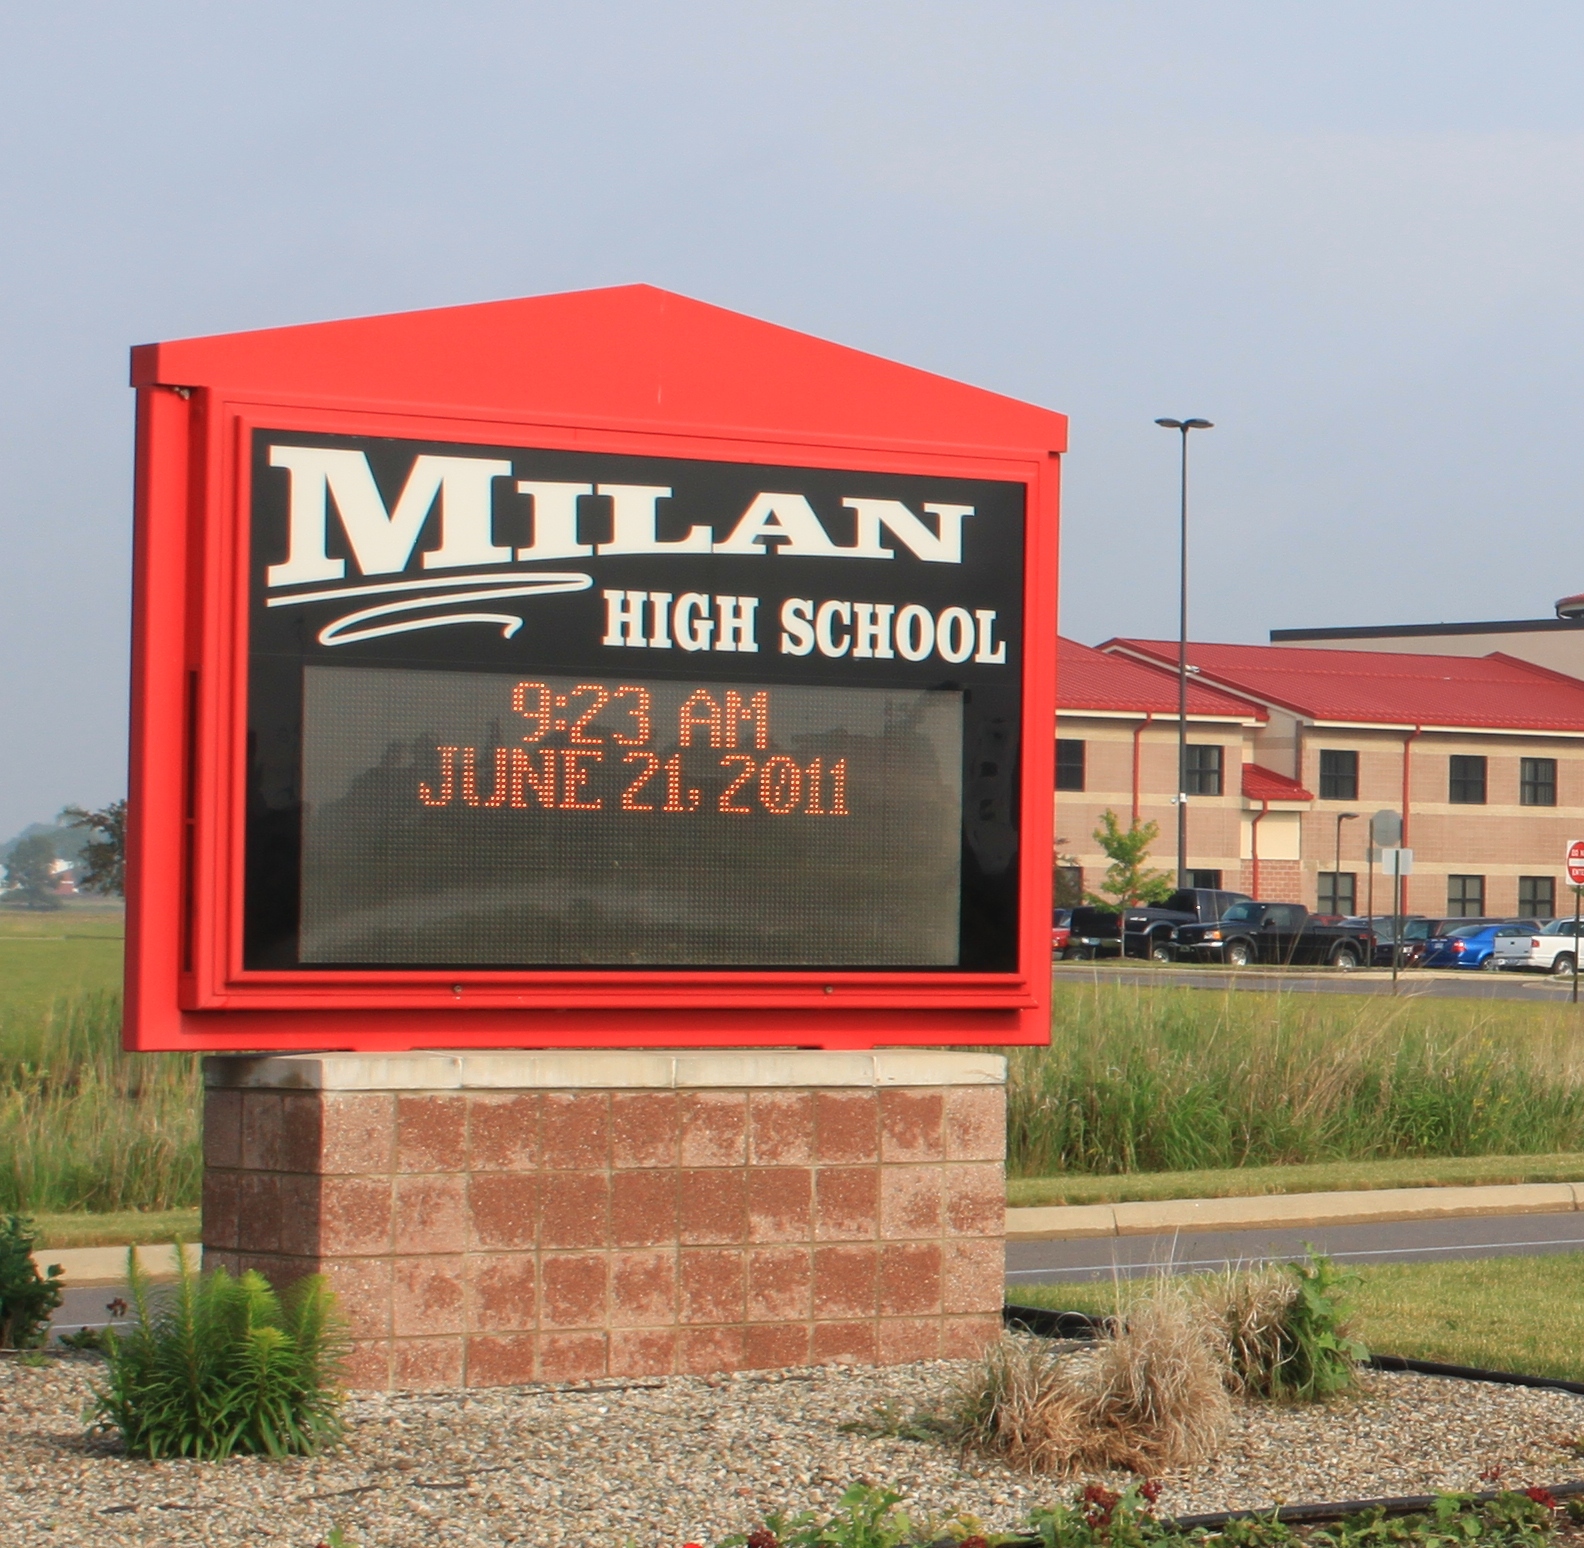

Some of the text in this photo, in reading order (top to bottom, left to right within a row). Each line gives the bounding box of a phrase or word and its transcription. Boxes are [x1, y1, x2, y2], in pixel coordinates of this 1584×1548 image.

[267, 444, 974, 588] MILAN
[602, 588, 1007, 665] HIGH SCHOOL
[512, 682, 768, 750] 9:23 AM
[418, 745, 603, 810] JUNE
[718, 754, 850, 816] 2011
